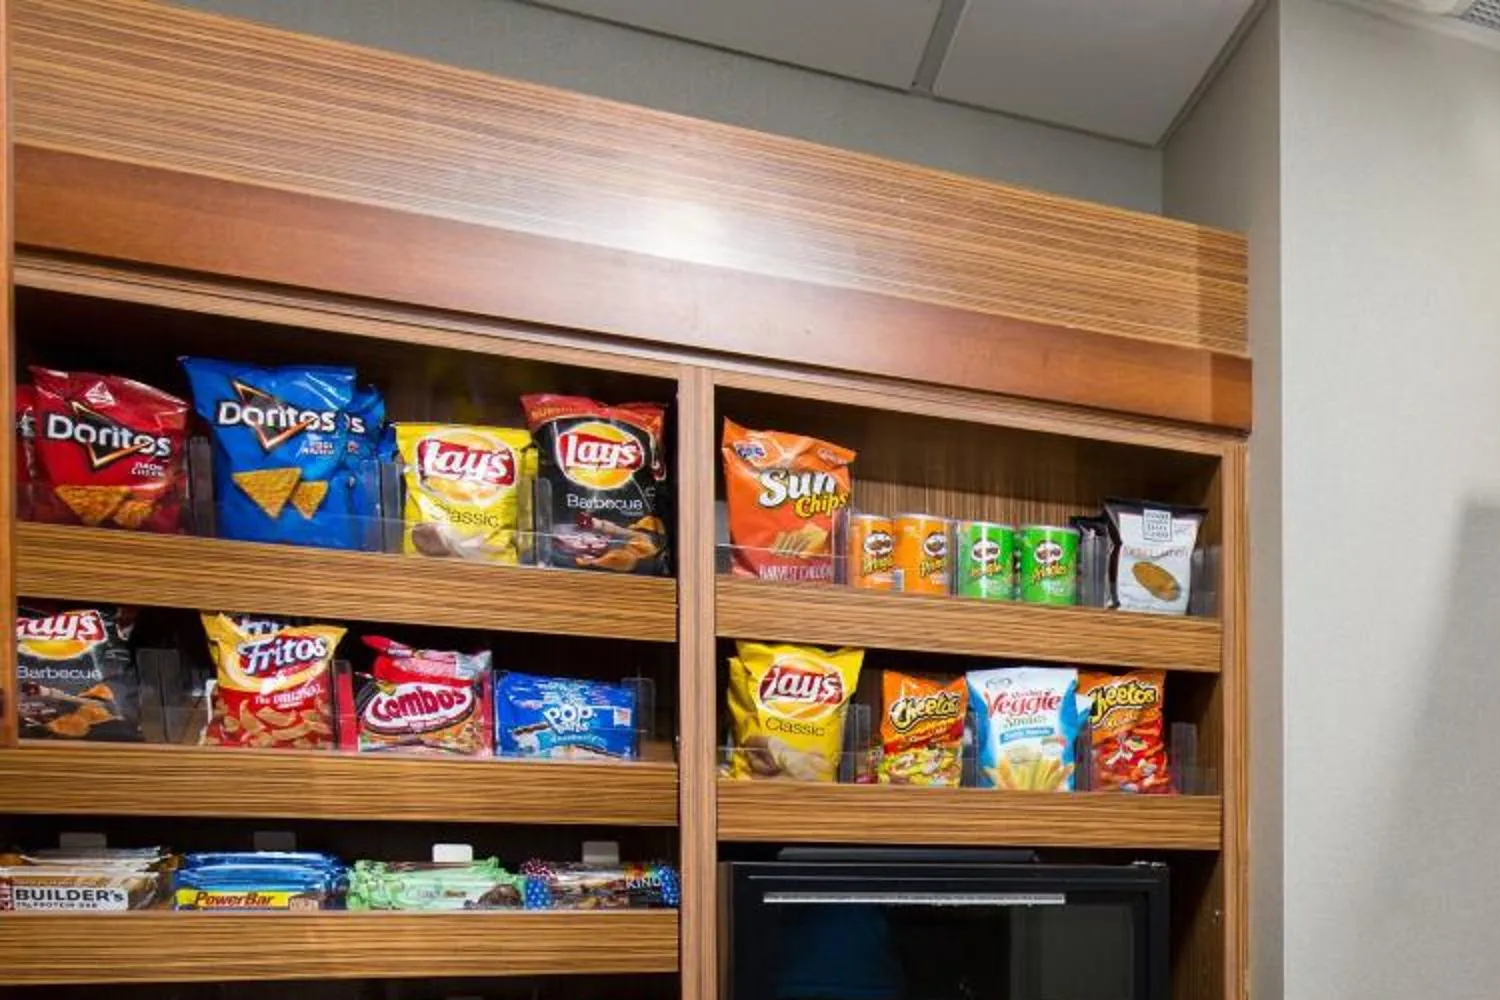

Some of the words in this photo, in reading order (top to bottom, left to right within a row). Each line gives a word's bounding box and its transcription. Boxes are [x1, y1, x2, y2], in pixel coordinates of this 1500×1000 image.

[217, 400, 337, 434] Doritos
[47, 413, 172, 458] Doritos
[567, 494, 643, 511] Barbecue
[758, 470, 836, 508] Sun
[795, 493, 849, 518] Chips
[237, 638, 328, 674] Fritos
[17, 665, 103, 680] Barbecue
[371, 685, 467, 721] Combos
[891, 692, 961, 731] Cheetos
[989, 690, 1062, 719] Veggie
[765, 717, 826, 737] Classic
[194, 891, 274, 908] PowerBar
